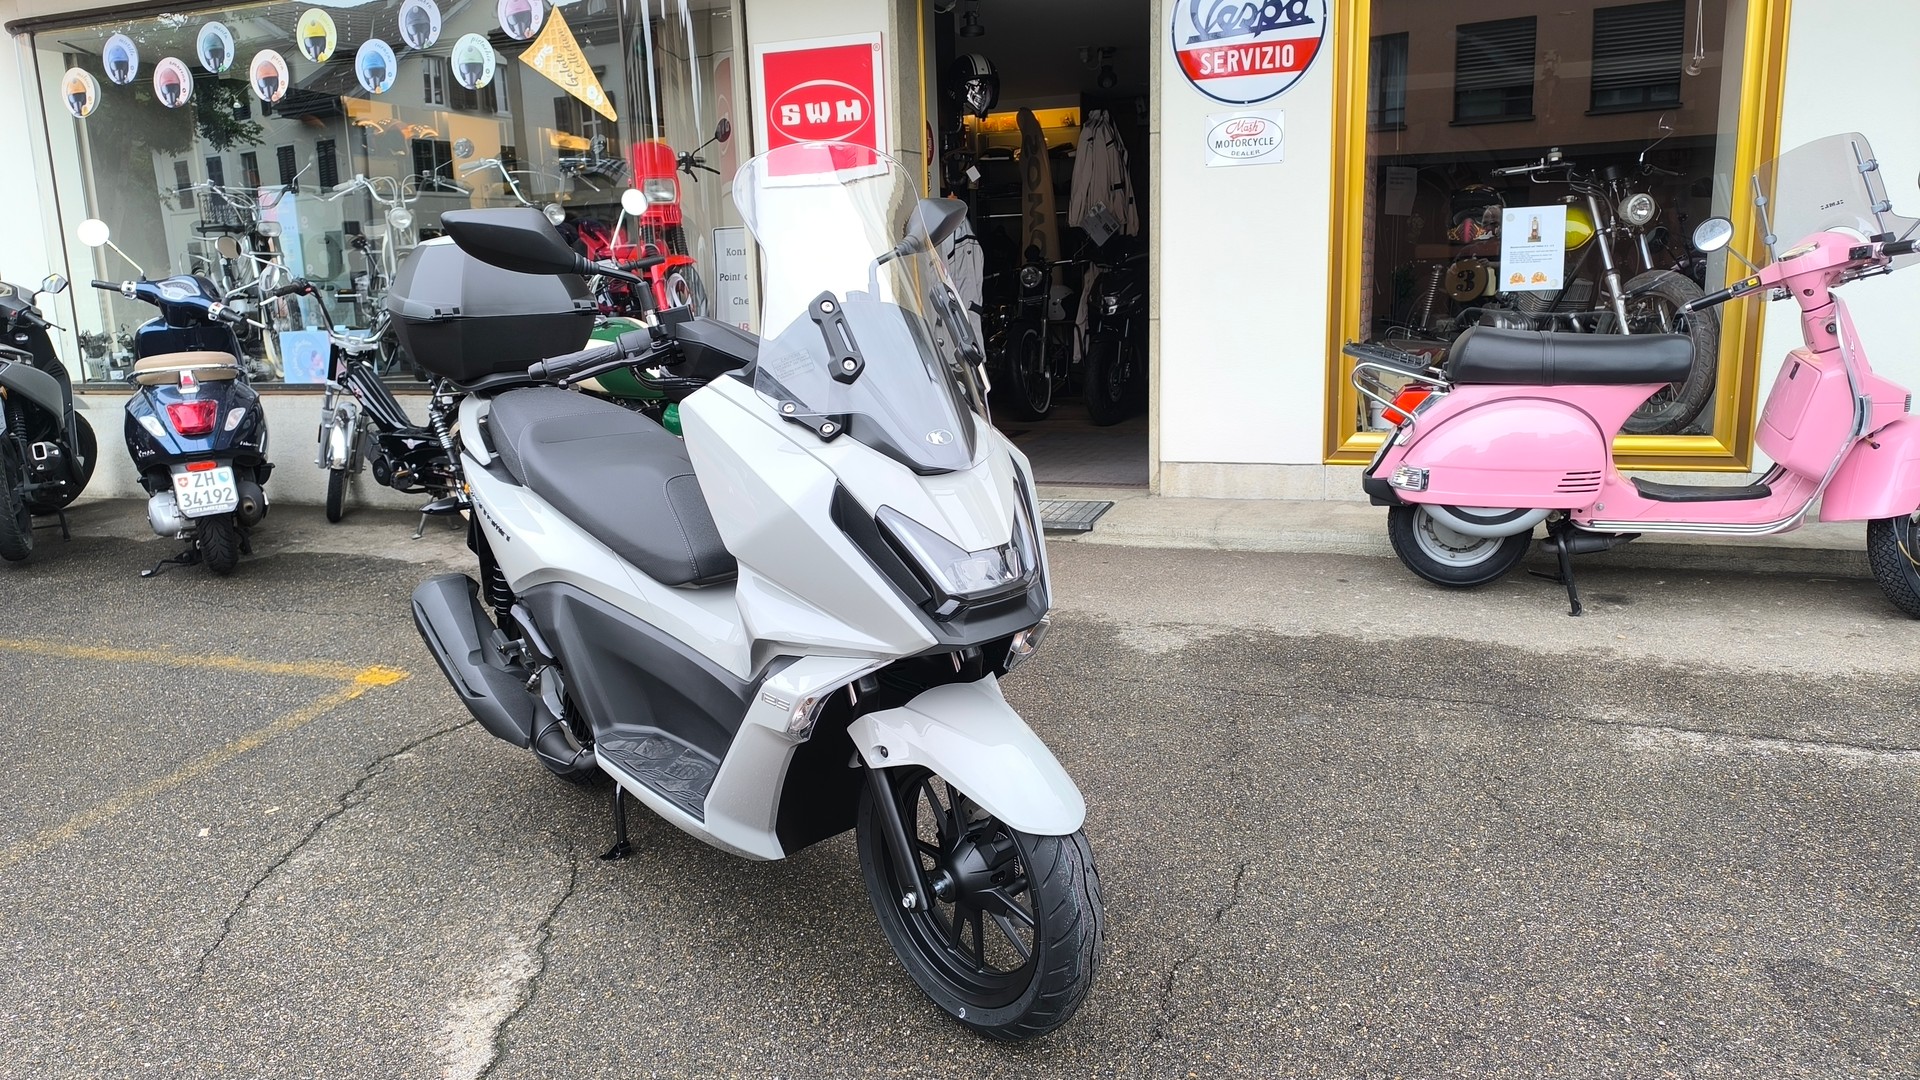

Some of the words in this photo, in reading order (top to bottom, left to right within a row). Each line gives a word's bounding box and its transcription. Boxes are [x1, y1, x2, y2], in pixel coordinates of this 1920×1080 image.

[1186, 0, 1315, 45] Vespa
[556, 54, 579, 87] Gelato
[1199, 44, 1295, 75] SERVIZIO
[781, 99, 862, 126] SWM
[1226, 119, 1266, 140] Mash
[1215, 137, 1274, 149] MOTORCYCLE
[1456, 269, 1475, 292] 3
[192, 472, 215, 488] ZH
[182, 486, 234, 508] 34192
